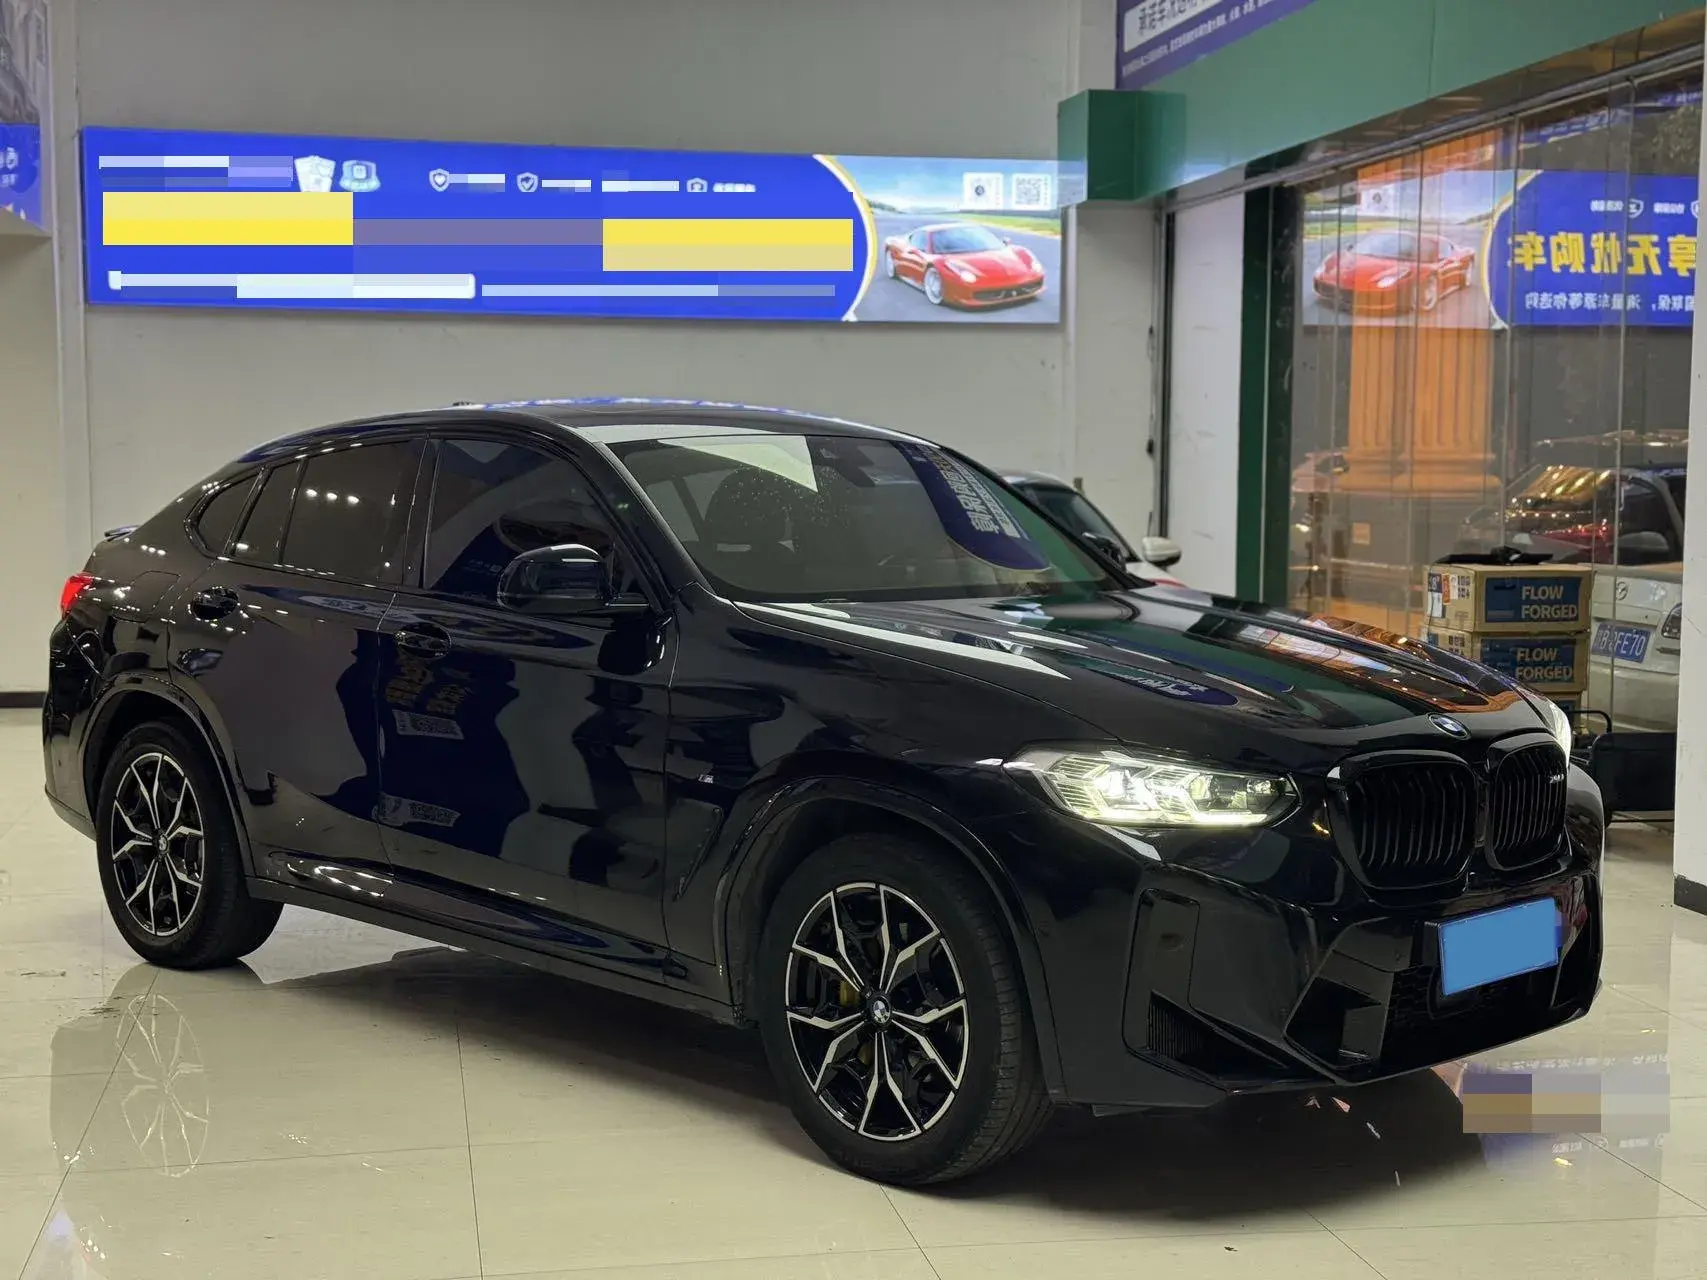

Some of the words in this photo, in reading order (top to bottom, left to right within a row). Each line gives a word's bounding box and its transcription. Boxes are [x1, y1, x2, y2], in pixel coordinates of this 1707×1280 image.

[1521, 585, 1564, 600] FLOW
[1521, 604, 1577, 619] FORGED
[1516, 647, 1557, 662] FLOW
[1515, 665, 1573, 680] FORGED
